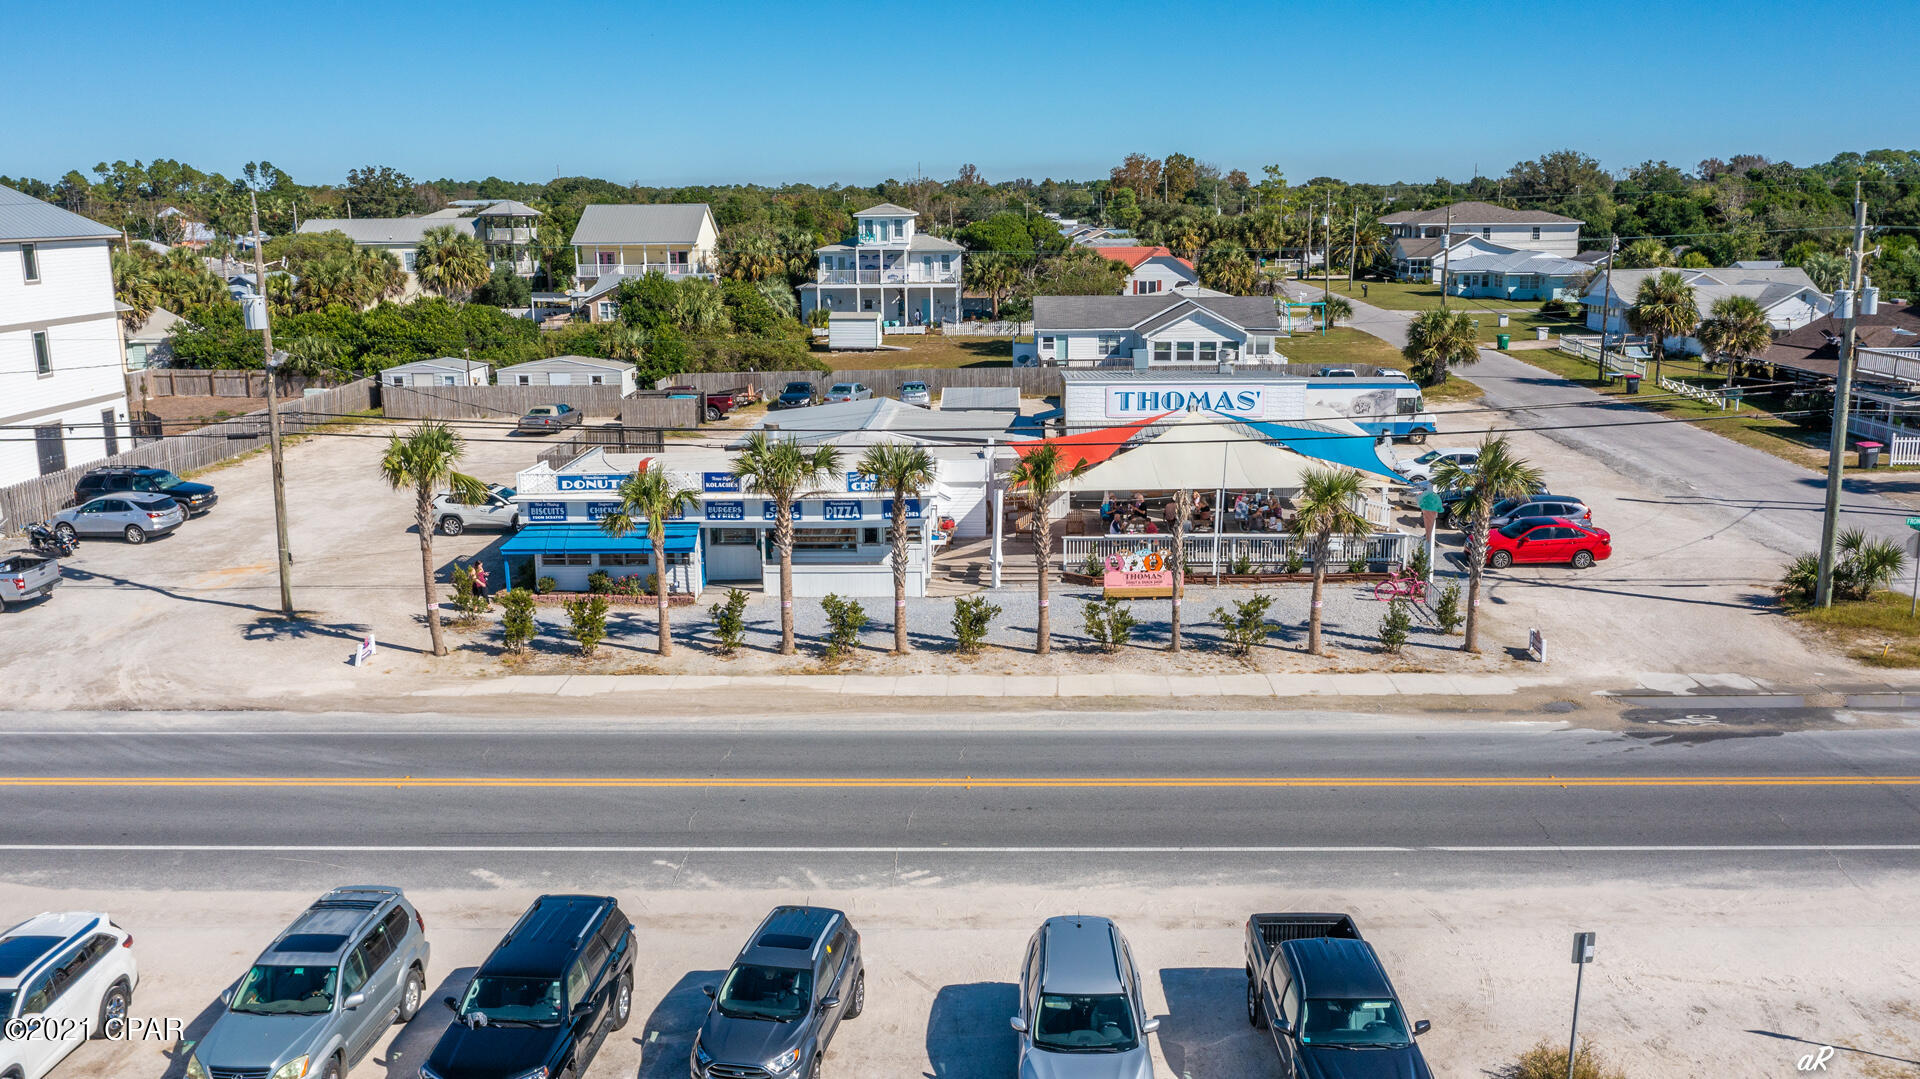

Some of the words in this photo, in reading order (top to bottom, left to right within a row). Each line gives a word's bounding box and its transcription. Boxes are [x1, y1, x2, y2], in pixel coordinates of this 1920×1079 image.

[1114, 391, 1261, 412] THOMAS'
[530, 507, 565, 515] BISCUITS
[708, 506, 742, 514] BURGERS
[826, 506, 860, 519] PIZZA
